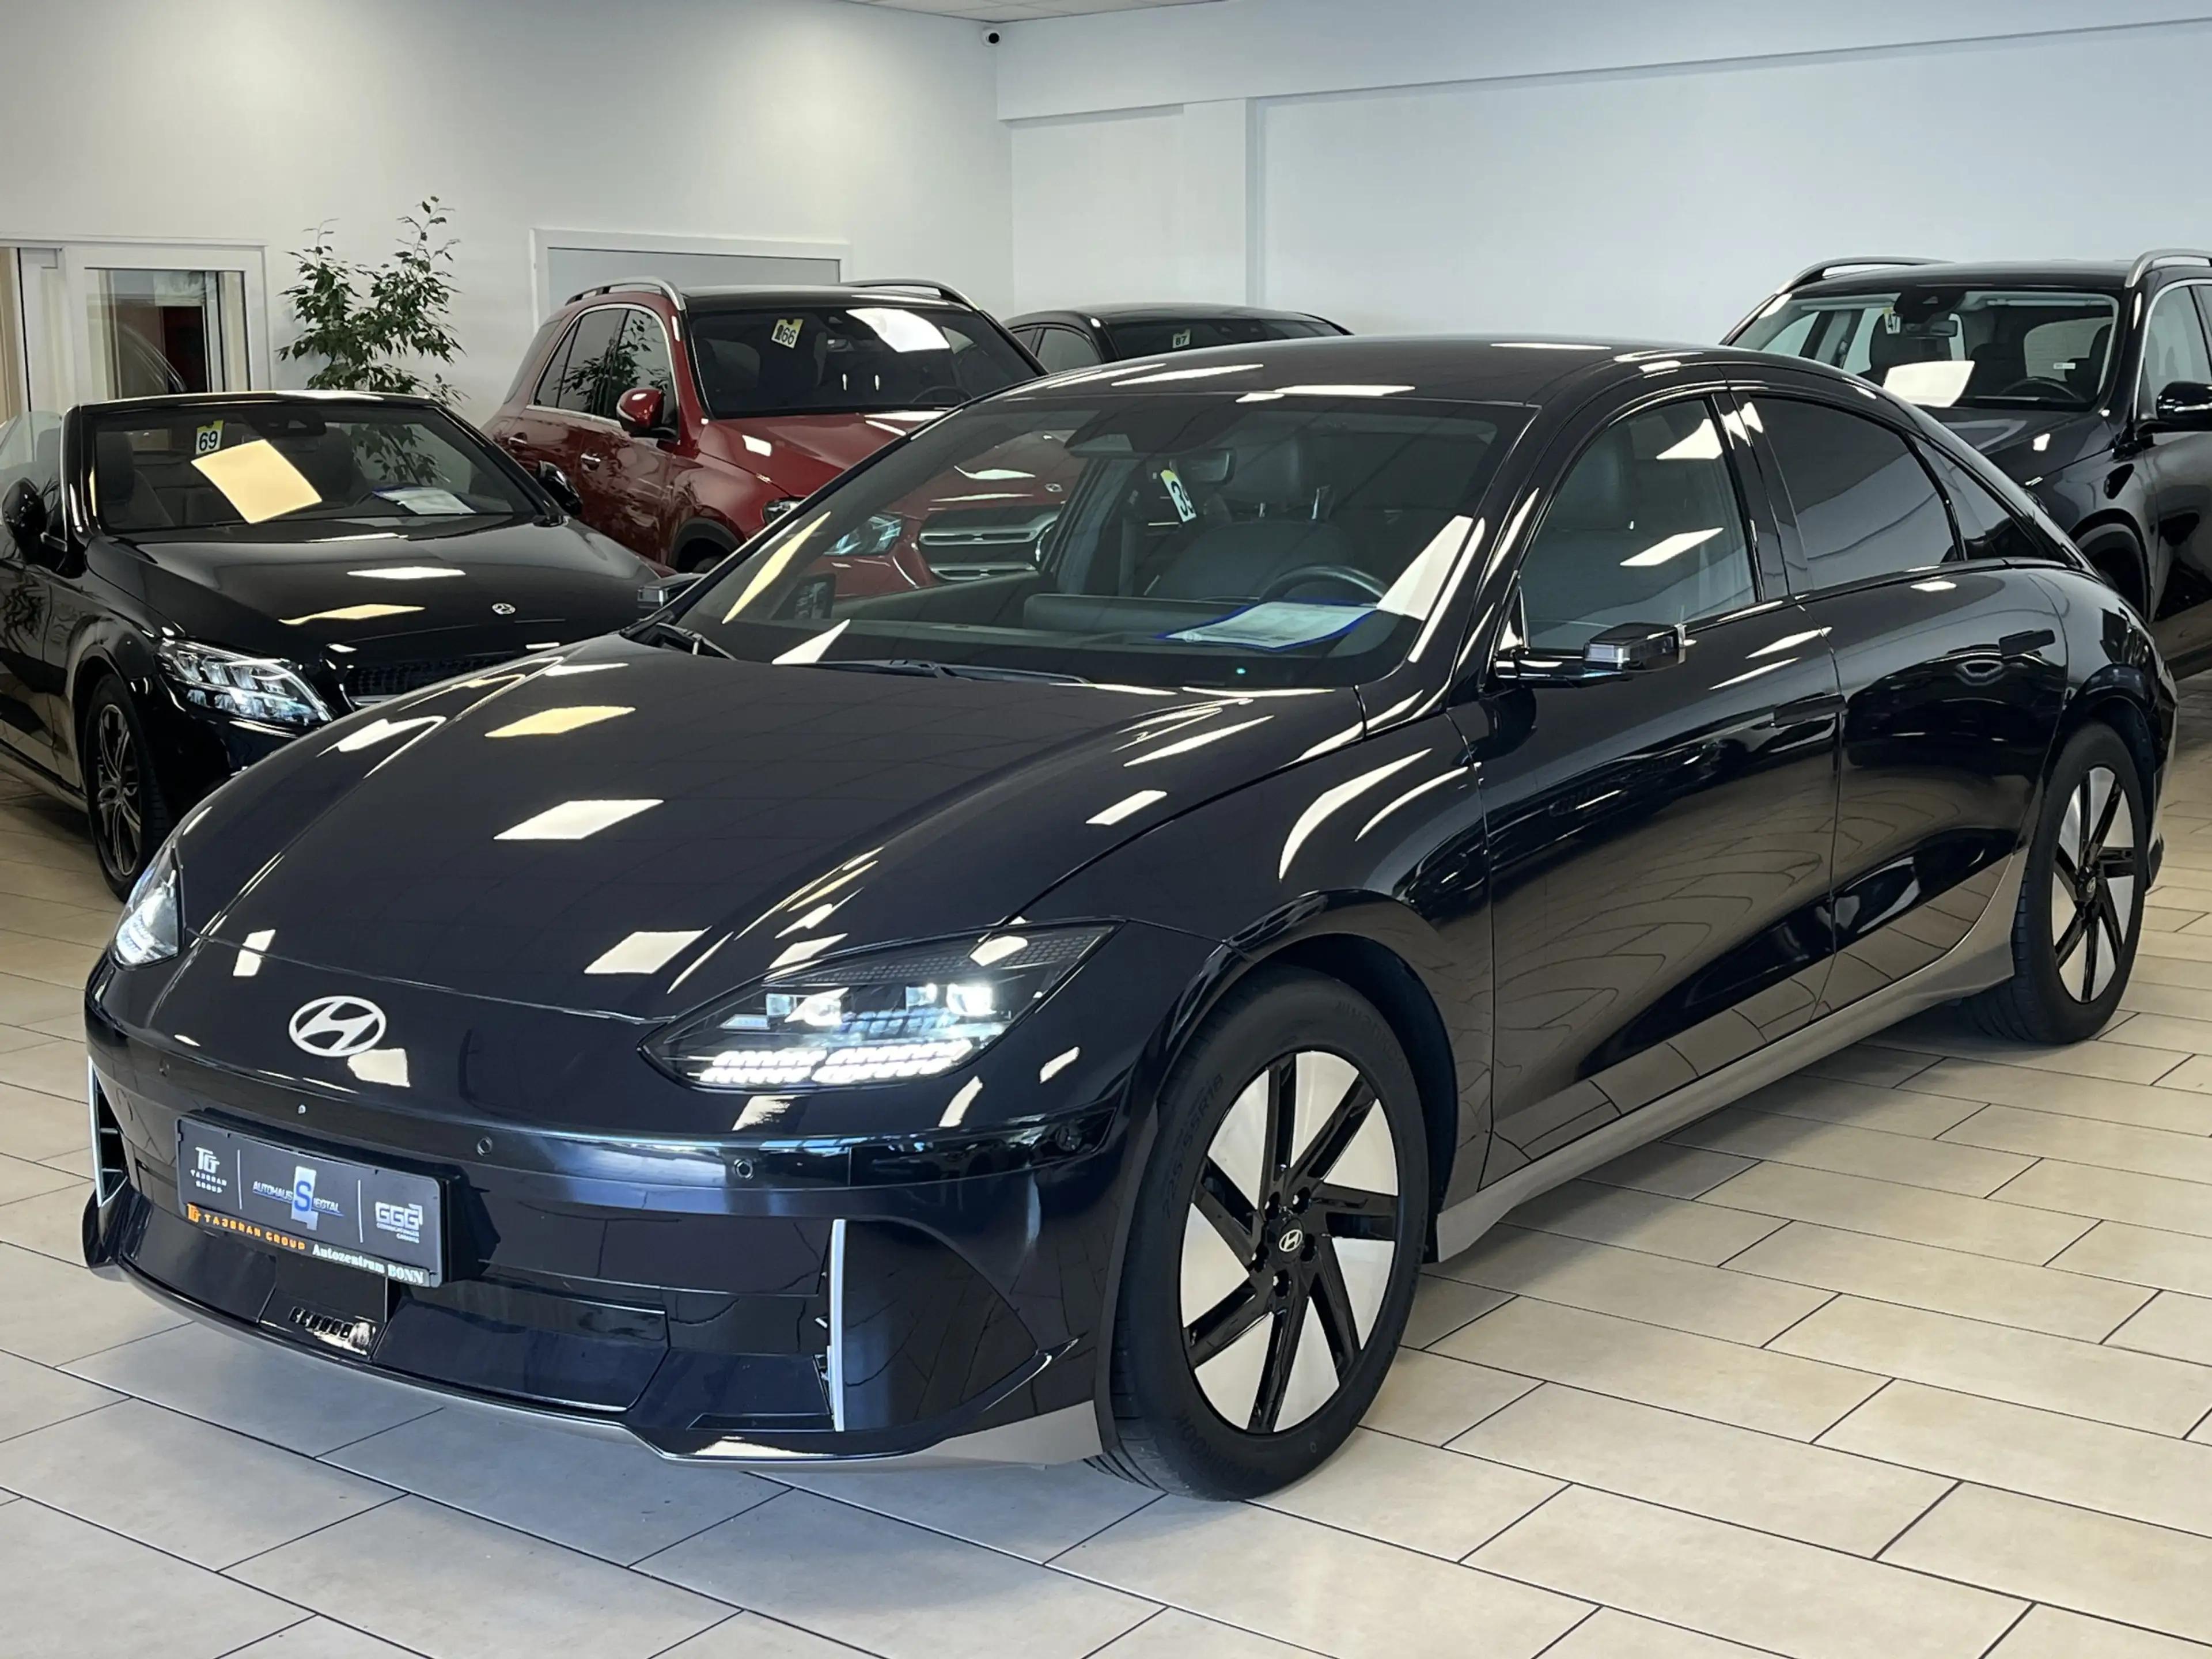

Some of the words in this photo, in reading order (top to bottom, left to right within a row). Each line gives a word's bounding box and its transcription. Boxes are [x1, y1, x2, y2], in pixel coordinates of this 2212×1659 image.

[199, 430, 218, 452] 69
[252, 1180, 294, 1200] AUTOHAUS
[266, 1231, 305, 1250] GROUP
[312, 1244, 385, 1274] Autozentrum
[387, 1264, 424, 1285] BONN
